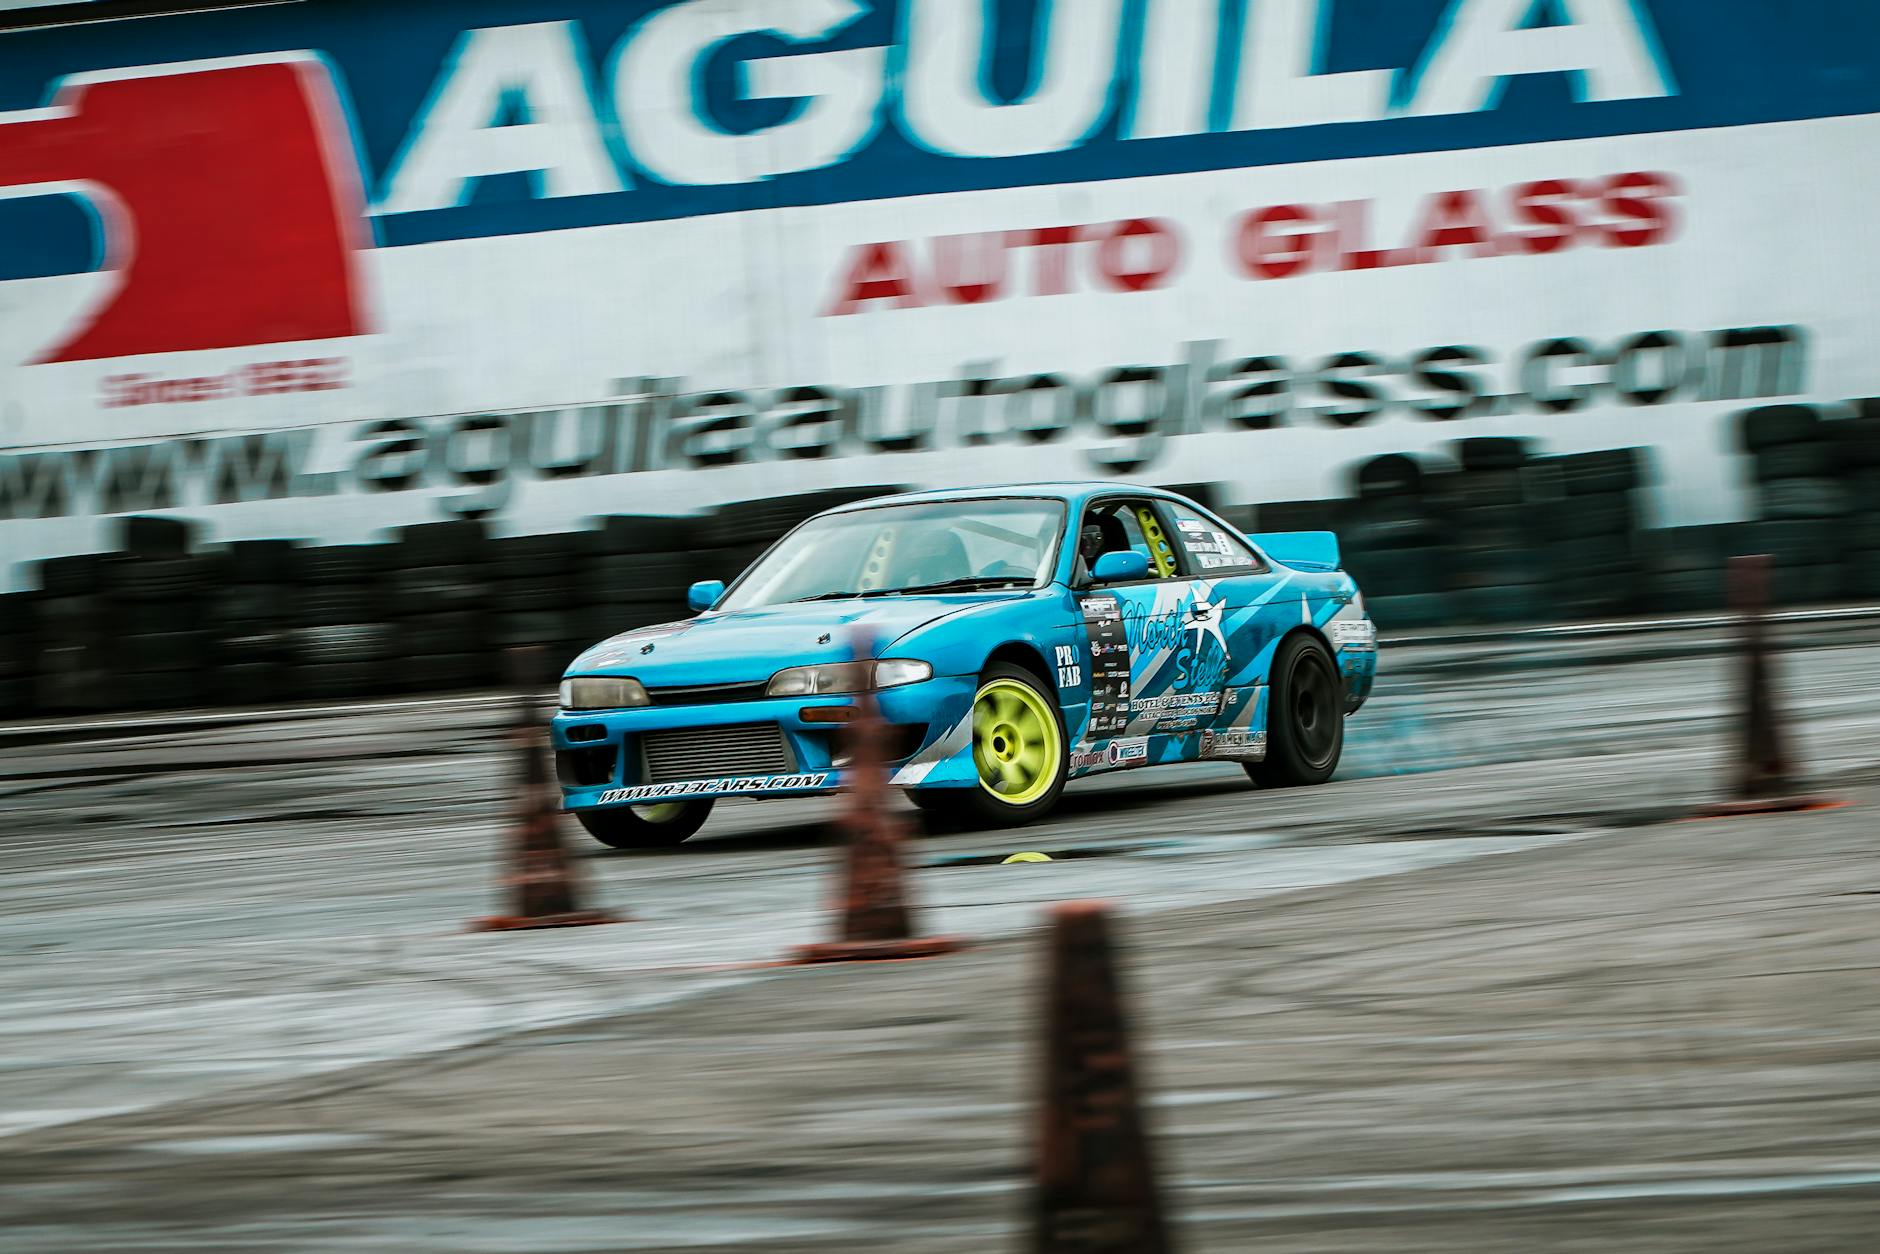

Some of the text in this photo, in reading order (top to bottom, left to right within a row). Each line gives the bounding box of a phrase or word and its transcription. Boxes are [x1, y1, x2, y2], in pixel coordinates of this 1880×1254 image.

[369, 0, 1678, 216] AGUILA
[818, 170, 1686, 317] AUTO GLASS
[1122, 598, 1189, 654] North
[1055, 645, 1080, 667] PRO
[1057, 665, 1082, 689] FAB
[1130, 695, 1160, 712] HOTEL
